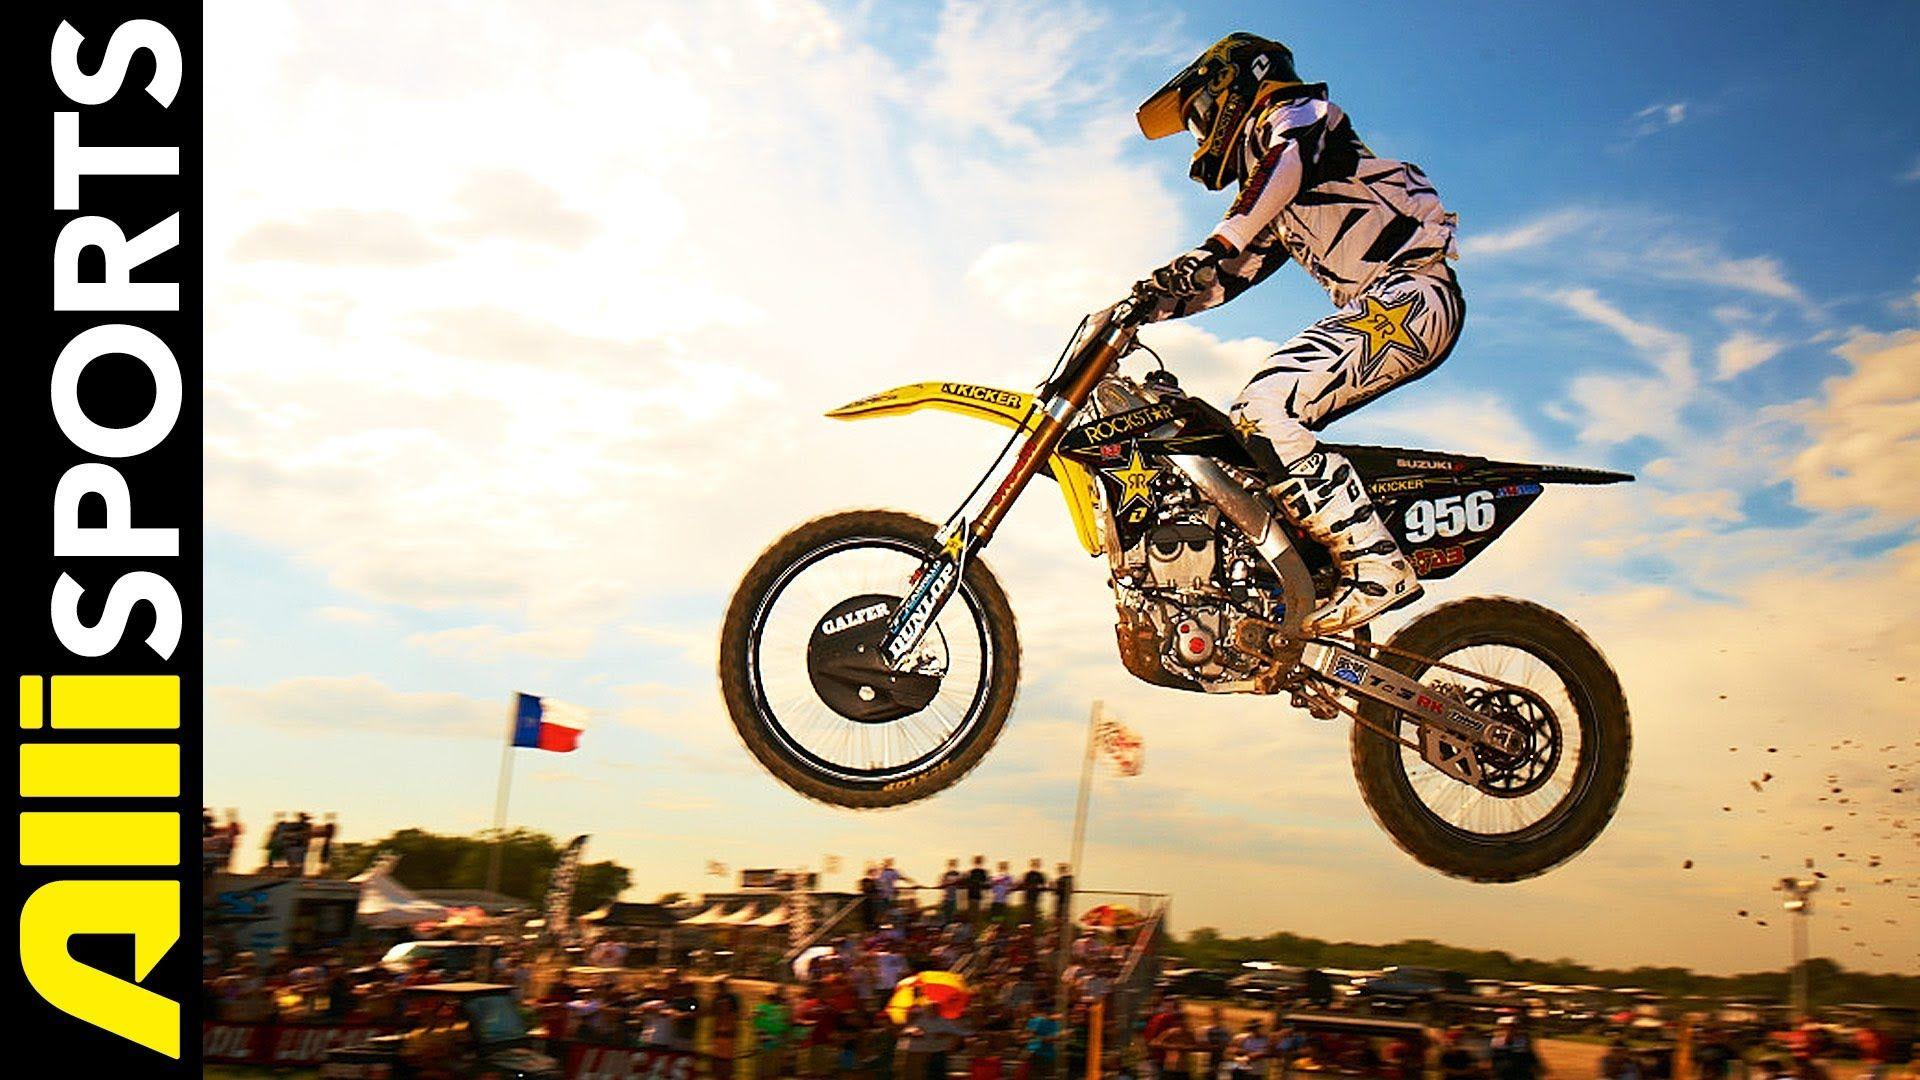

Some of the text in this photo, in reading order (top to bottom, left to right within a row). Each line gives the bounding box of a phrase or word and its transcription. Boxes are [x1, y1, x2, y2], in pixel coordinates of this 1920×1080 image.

[953, 384, 1021, 409] KICKER
[1396, 459, 1453, 471] SUZUKI
[1376, 480, 1424, 494] KICKER
[1404, 489, 1496, 544] 956
[821, 602, 891, 636] GALFER
[888, 561, 954, 660] DUNLOP
